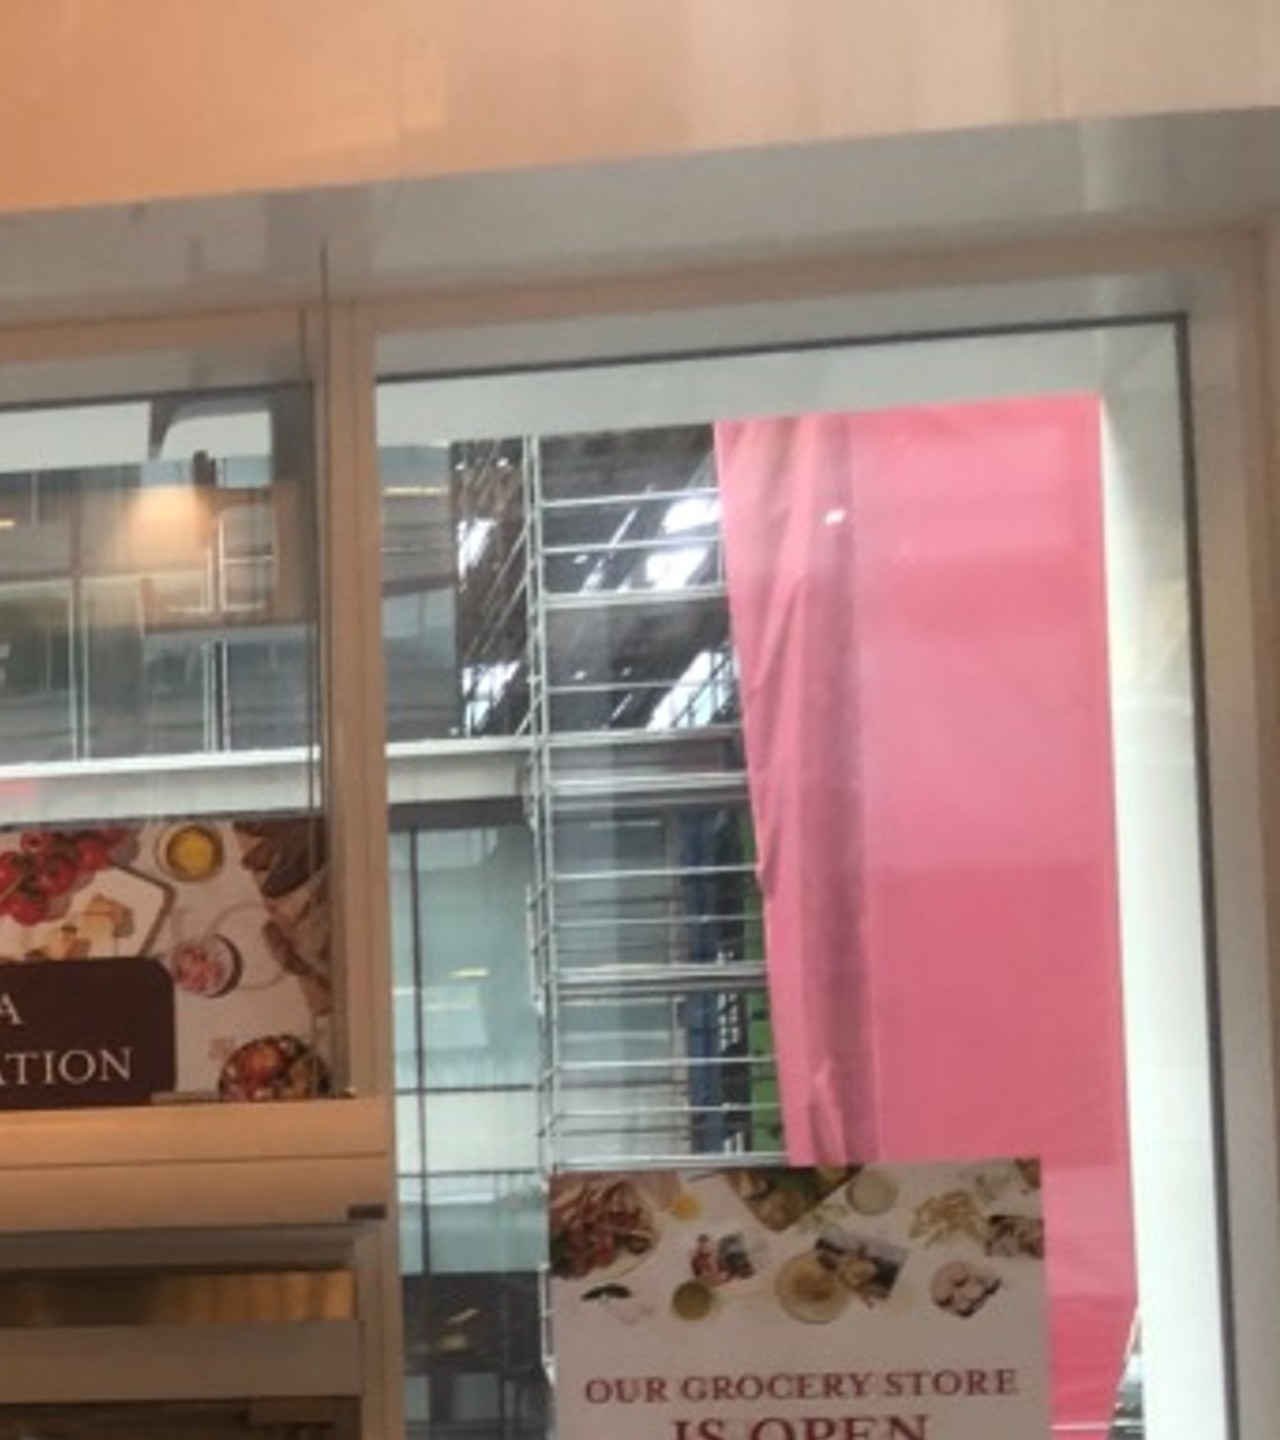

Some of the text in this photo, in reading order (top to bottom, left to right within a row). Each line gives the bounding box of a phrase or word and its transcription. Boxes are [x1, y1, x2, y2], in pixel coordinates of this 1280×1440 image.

[584, 1369, 1020, 1404] OUR GROCERY STORE
